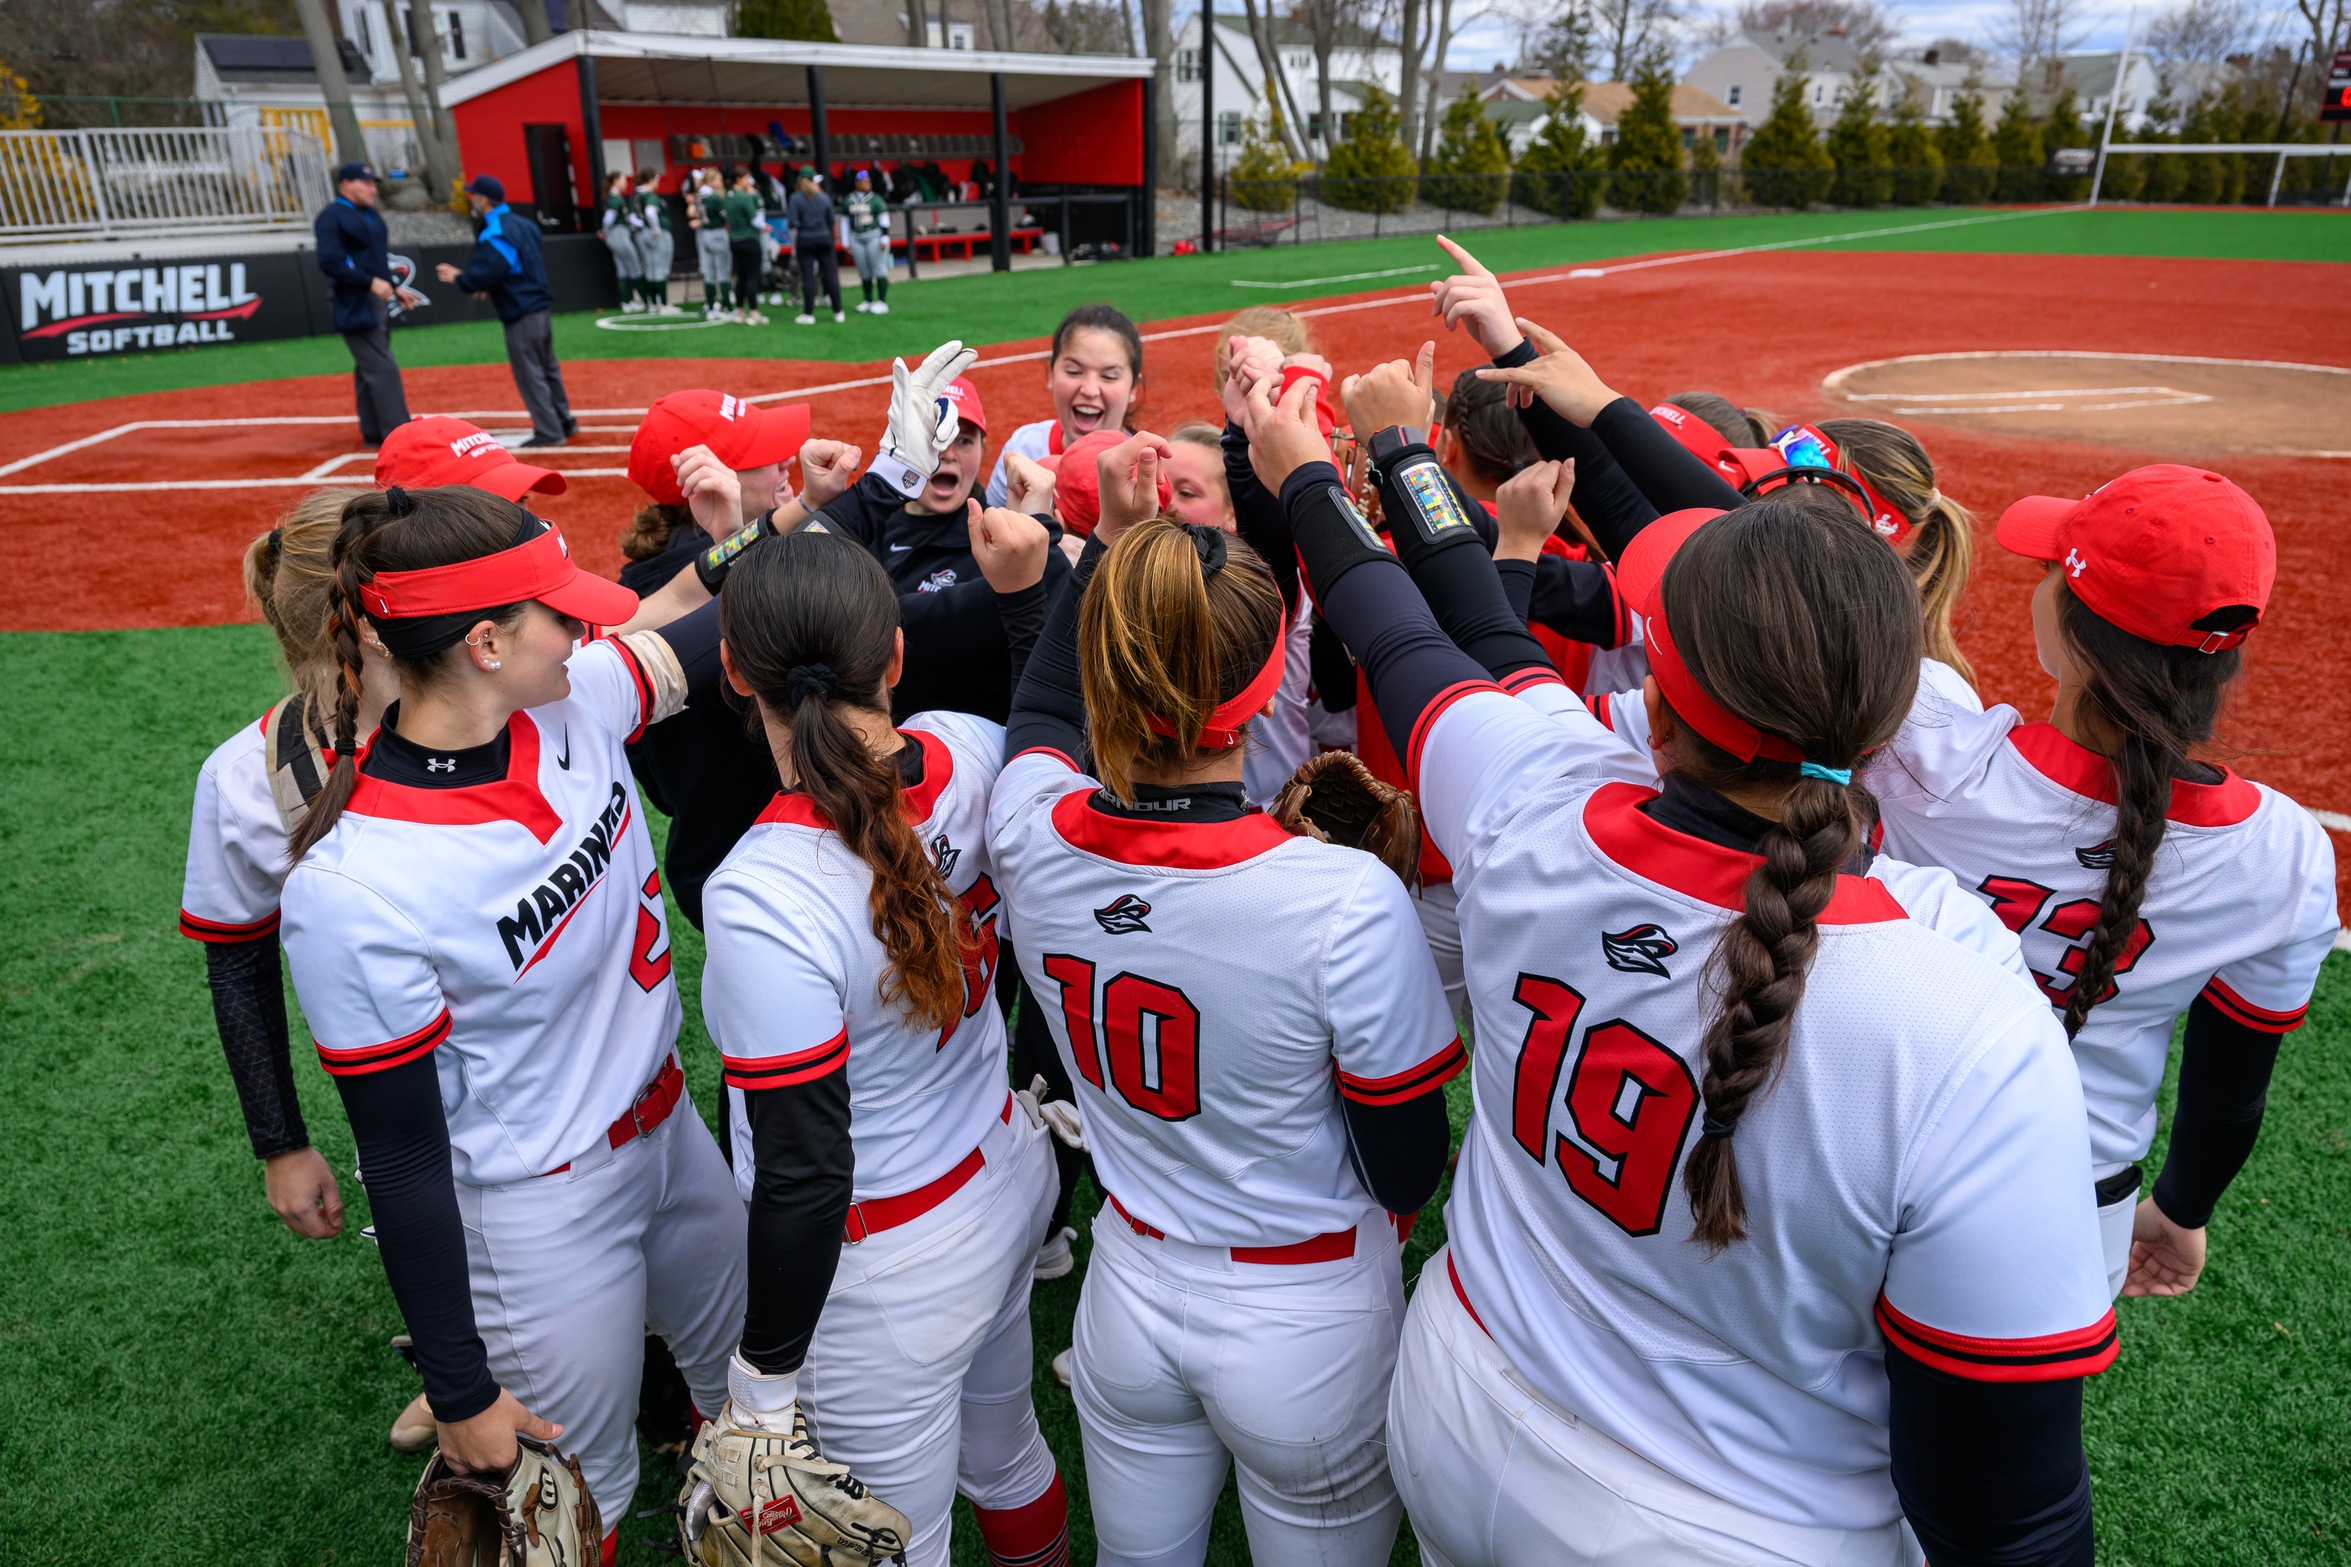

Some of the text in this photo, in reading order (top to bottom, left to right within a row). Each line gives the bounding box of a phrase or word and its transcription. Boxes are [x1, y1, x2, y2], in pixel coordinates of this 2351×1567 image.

[20, 263, 258, 331] MITCHELL
[67, 320, 234, 355] SOFTBALL
[1042, 953, 1202, 1122] 10
[1512, 971, 1702, 1238] 19
[751, 1506, 793, 1528] Rawlin
